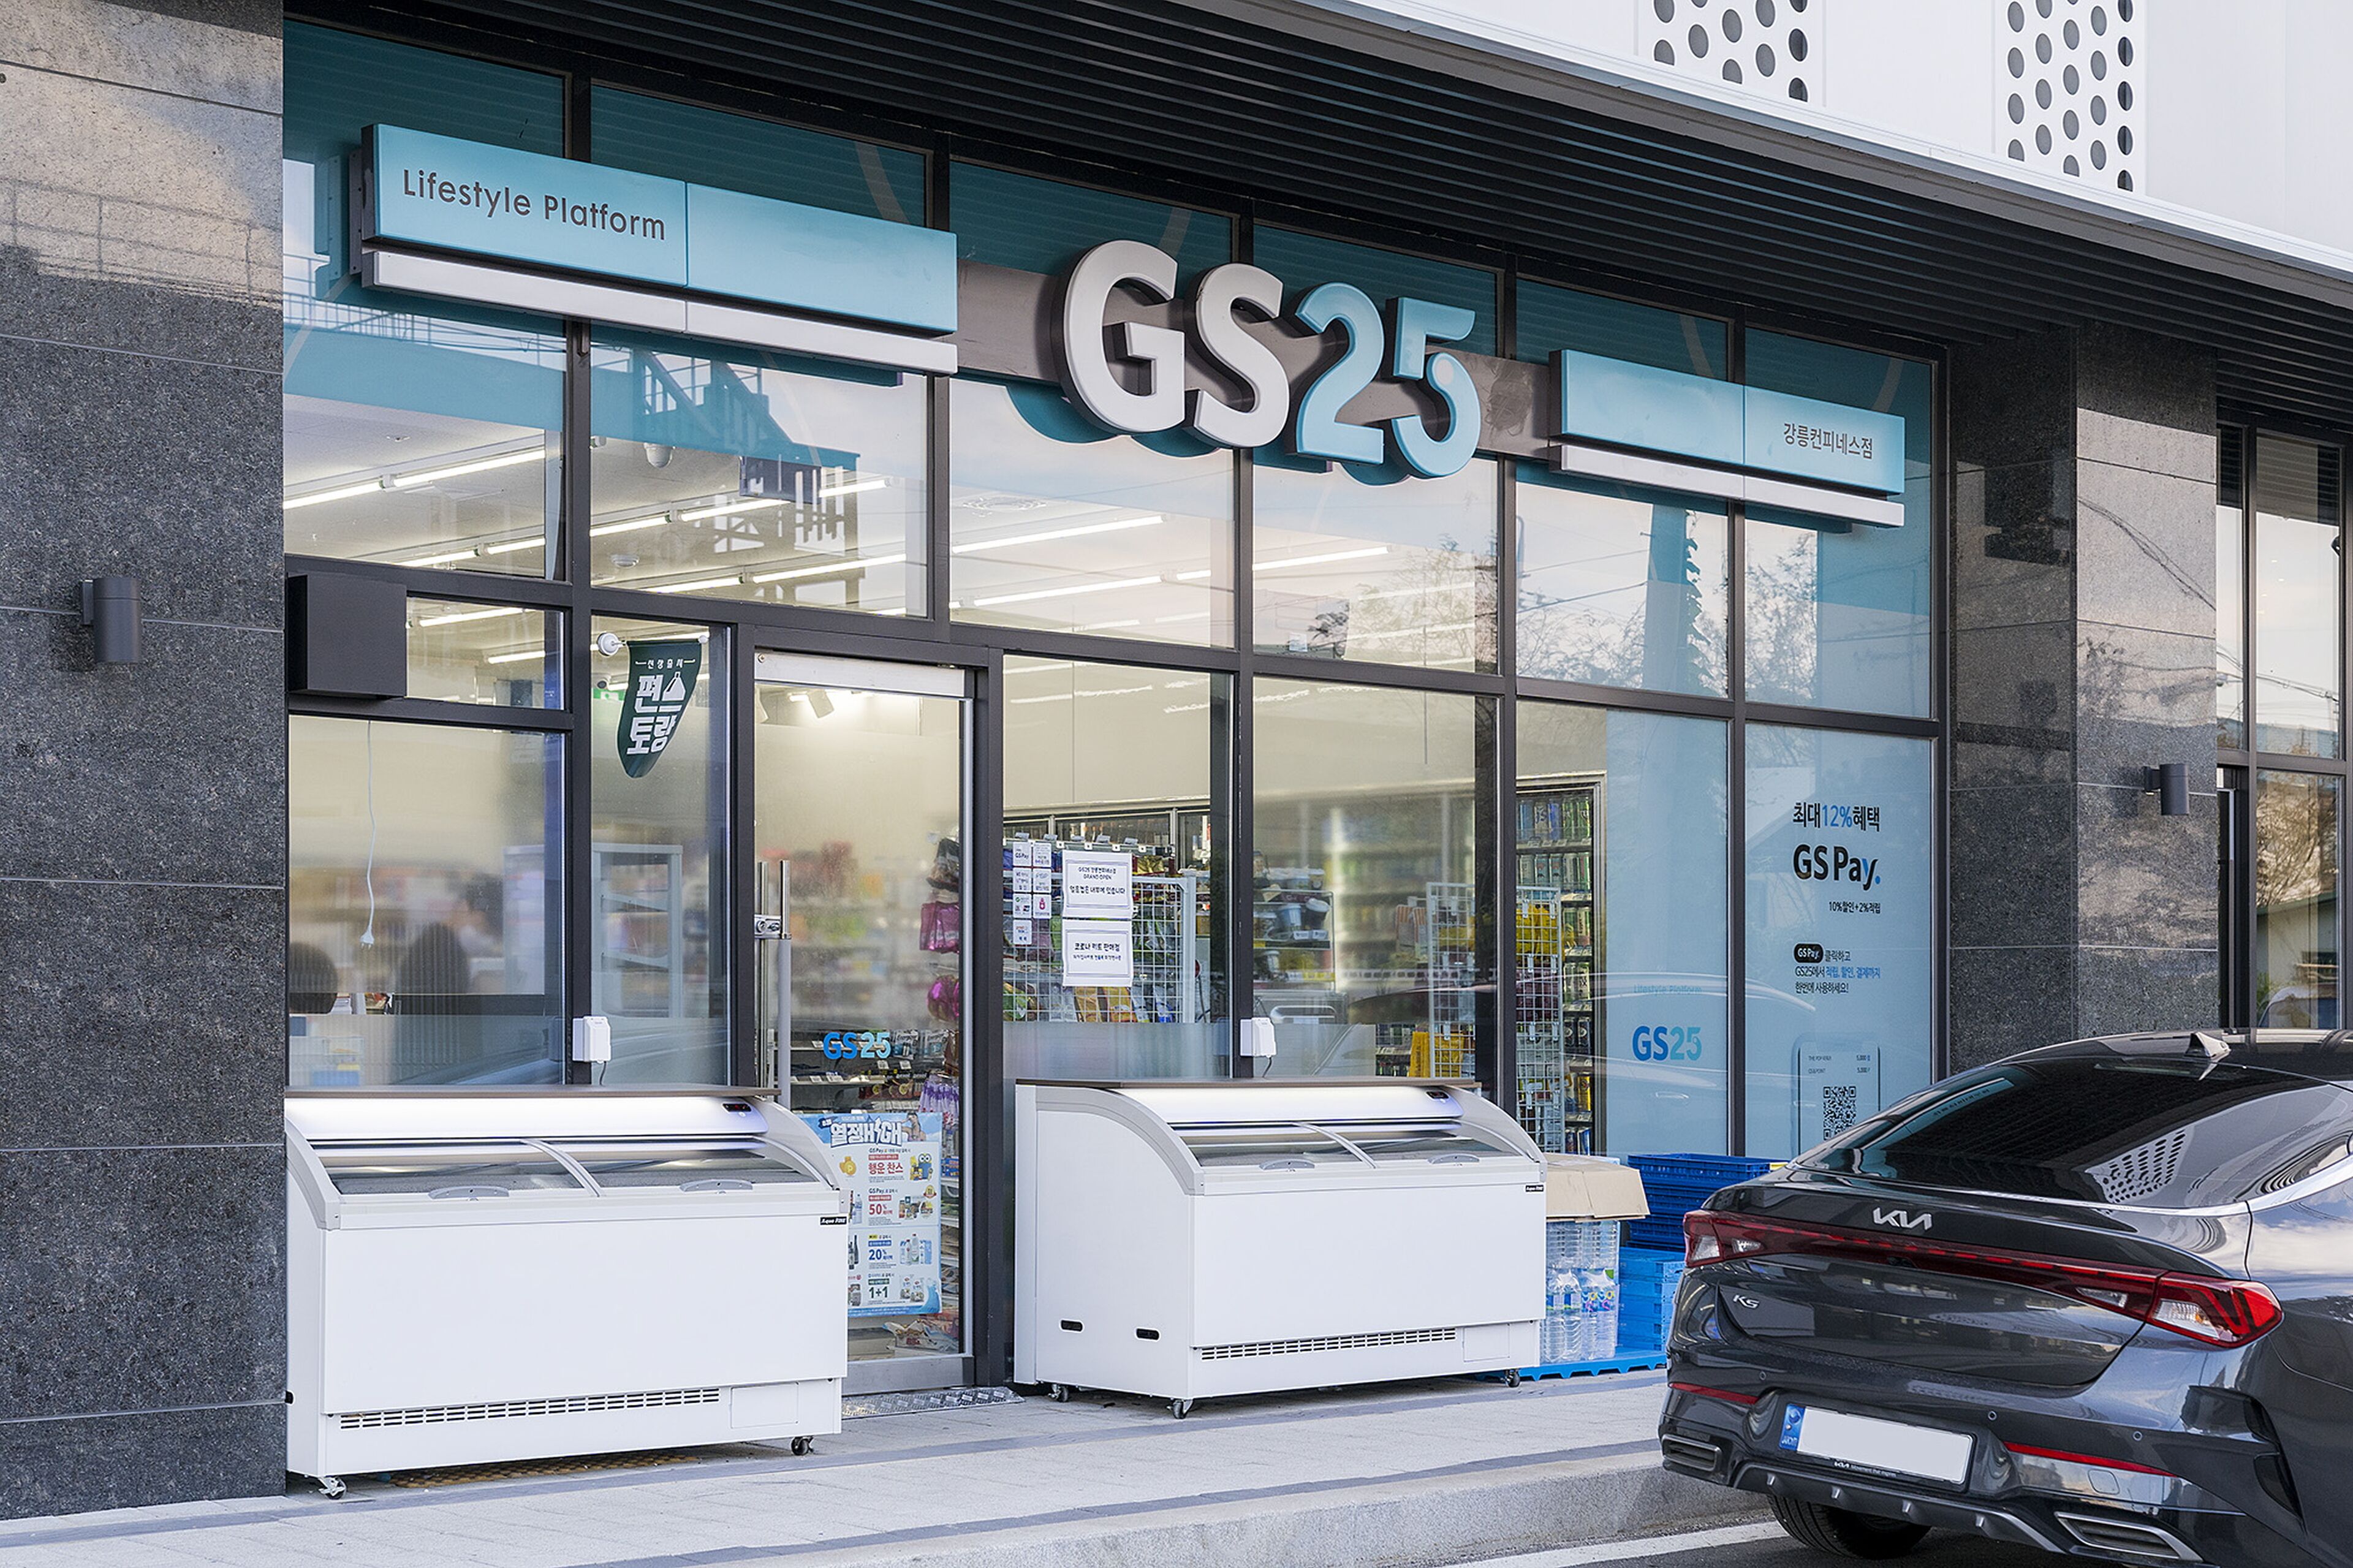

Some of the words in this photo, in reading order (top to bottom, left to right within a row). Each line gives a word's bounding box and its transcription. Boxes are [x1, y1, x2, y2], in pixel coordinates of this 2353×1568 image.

[403, 170, 530, 217] Lifestyle
[544, 195, 666, 241] Platform
[1062, 239, 1482, 479] GS25
[1784, 423, 1873, 460] 강릉컨피네스점
[823, 1031, 892, 1059] GS25
[1632, 1025, 1702, 1061] GS25
[887, 1162, 903, 1174] 찬스
[869, 1286, 889, 1298] 1+1
[1733, 1294, 1759, 1309] K5
